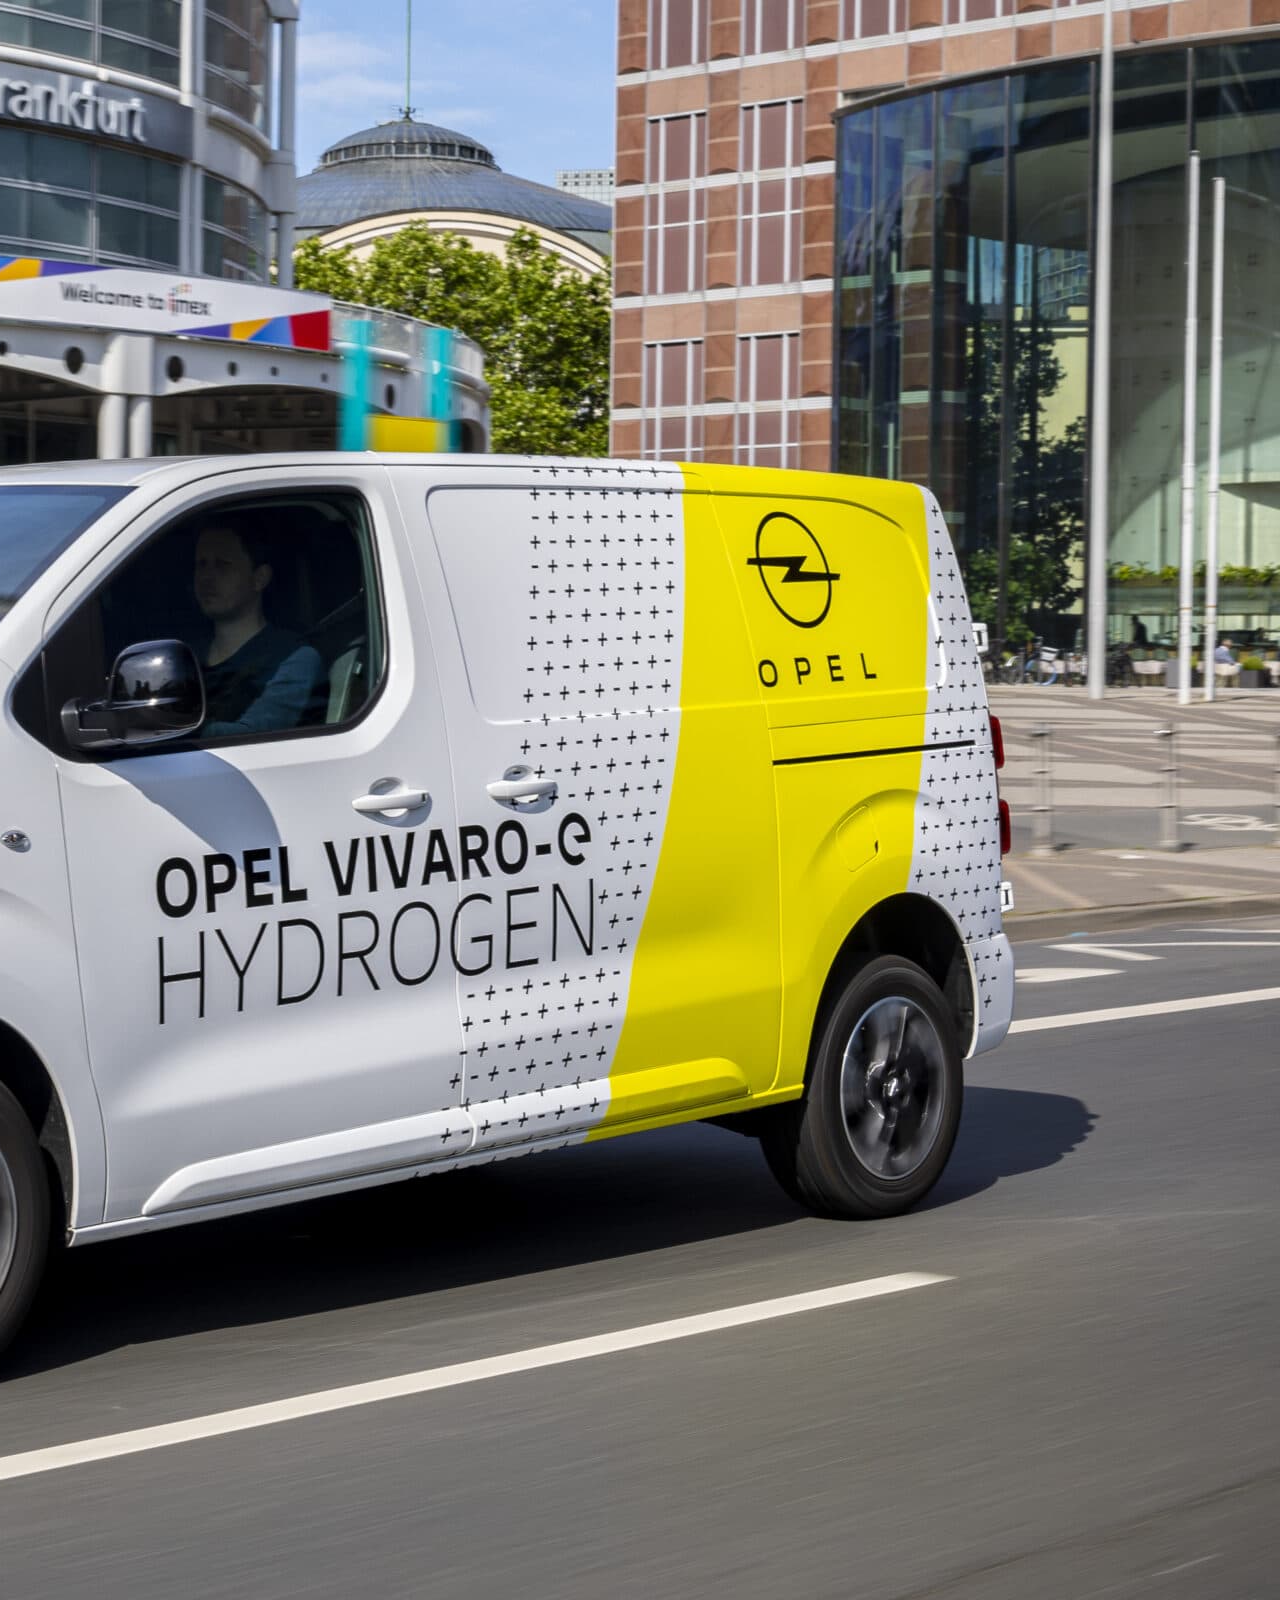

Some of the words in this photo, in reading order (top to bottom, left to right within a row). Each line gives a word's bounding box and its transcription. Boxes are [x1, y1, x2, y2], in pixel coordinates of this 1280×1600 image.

[59, 281, 144, 309] Welcome
[147, 292, 164, 310] to
[758, 652, 878, 688] OPEL
[156, 846, 308, 918] OPEL
[324, 812, 592, 897] VIVARO-e
[158, 878, 595, 1025] HYDROGEN
